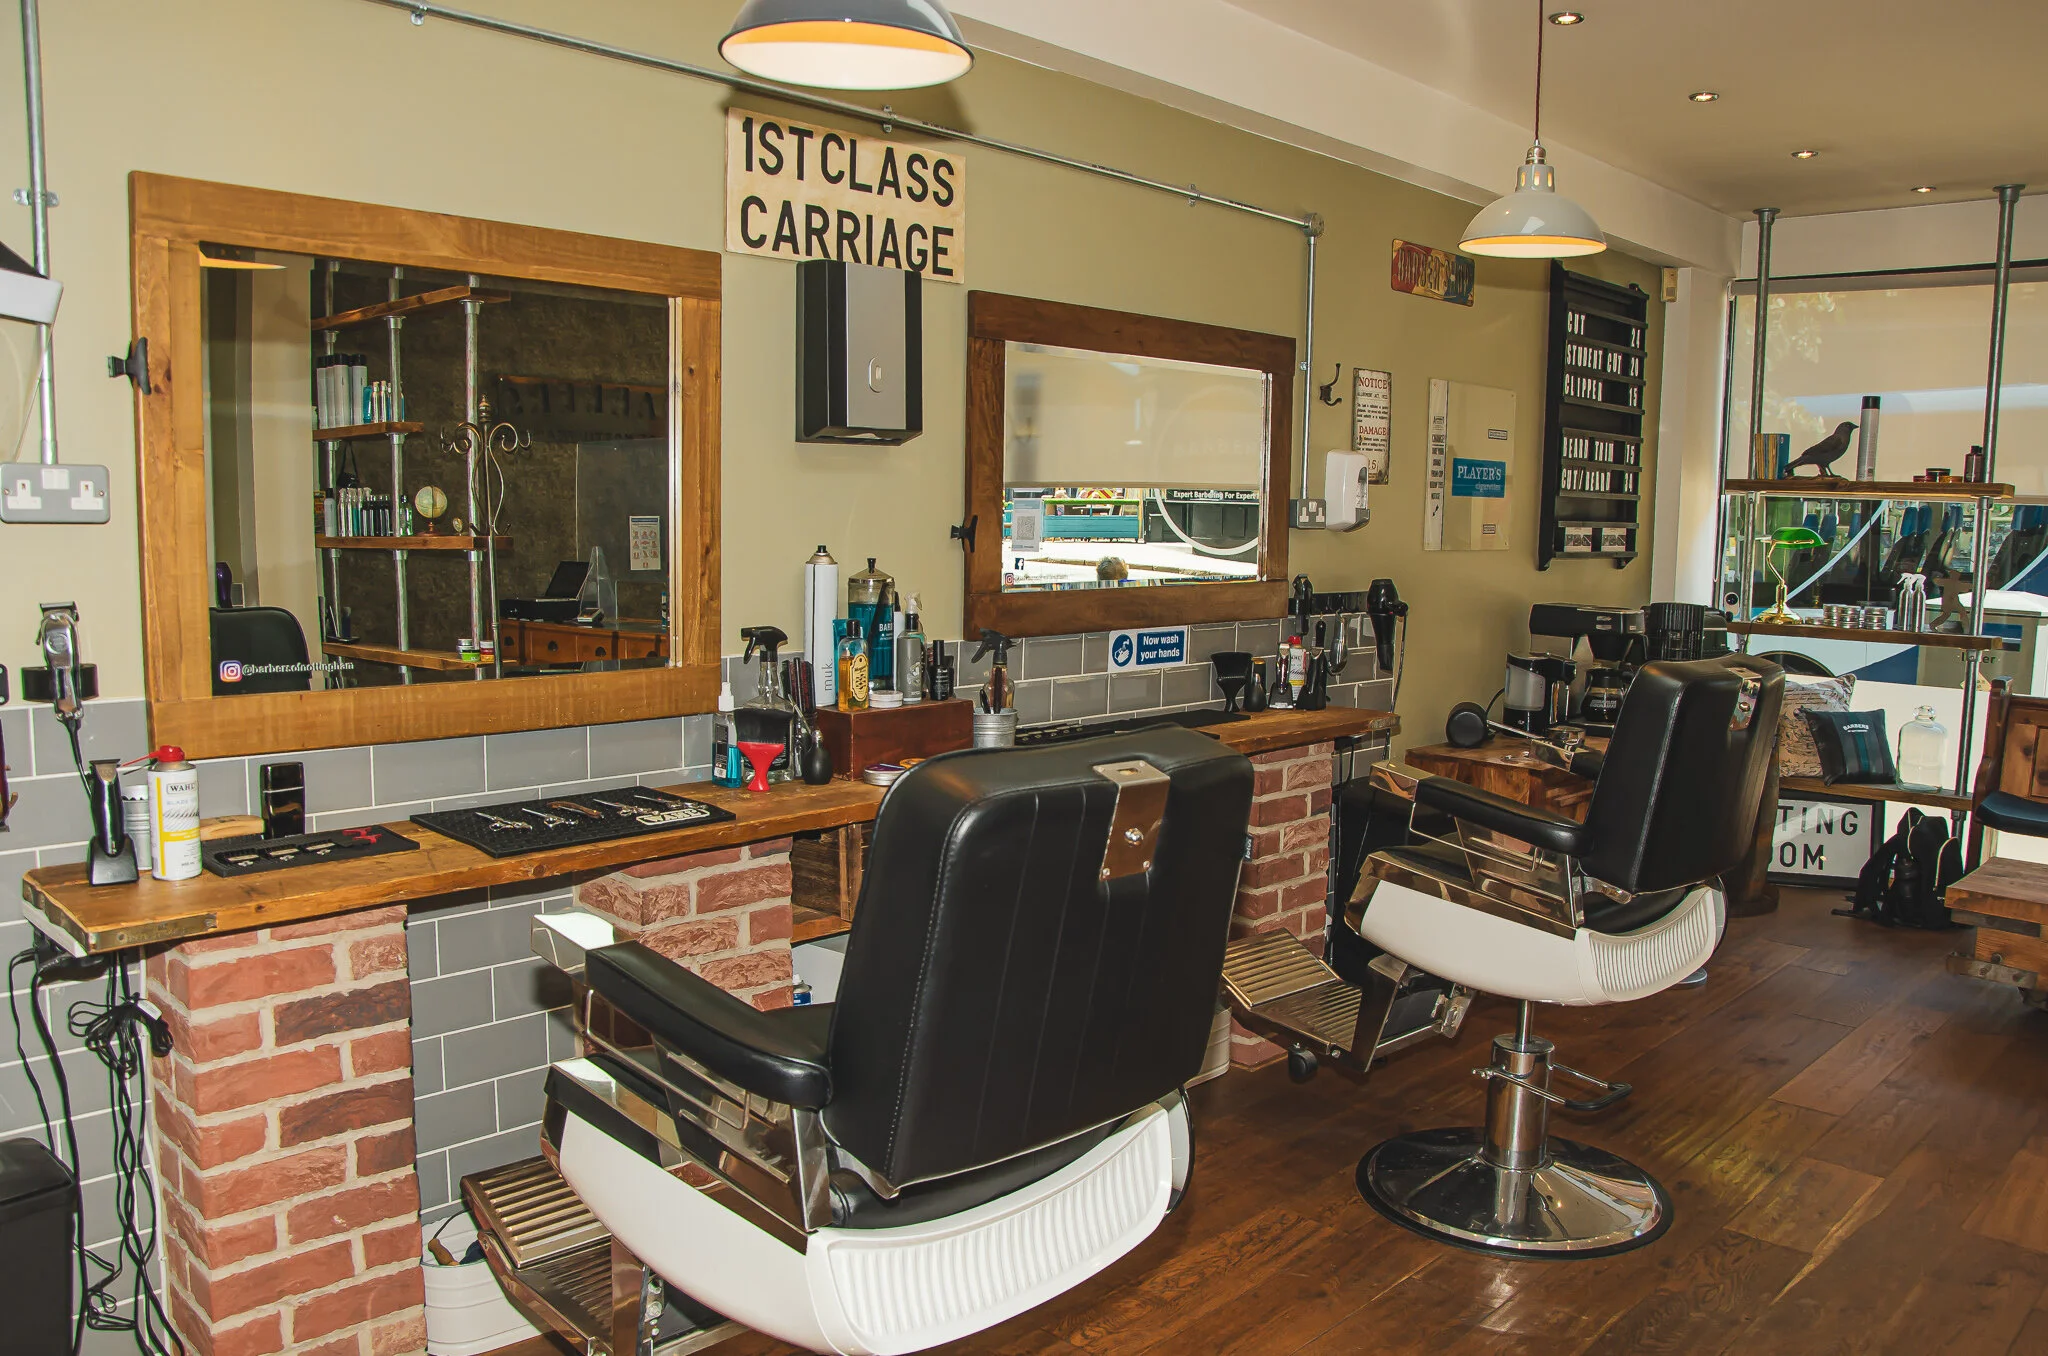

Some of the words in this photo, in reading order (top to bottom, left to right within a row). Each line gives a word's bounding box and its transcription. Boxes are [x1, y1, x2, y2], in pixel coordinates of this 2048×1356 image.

[740, 195, 954, 277] CARRIAGE
[1567, 311, 1586, 336] CUT
[1566, 343, 1603, 370] STUDENT
[1606, 352, 1622, 375] CUT
[1358, 376, 1388, 390] NOTICE
[1629, 387, 1638, 407] 15
[1358, 425, 1388, 436] DAMAGE
[1457, 465, 1502, 481] PLAYER'S
[1173, 490, 1194, 499] Expert
[1224, 491, 1235, 499] For
[1143, 635, 1159, 646] Now
[1160, 634, 1179, 644] wash
[1140, 650, 1157, 661] your
[1158, 647, 1180, 658] hands
[1769, 841, 1825, 871] OM
